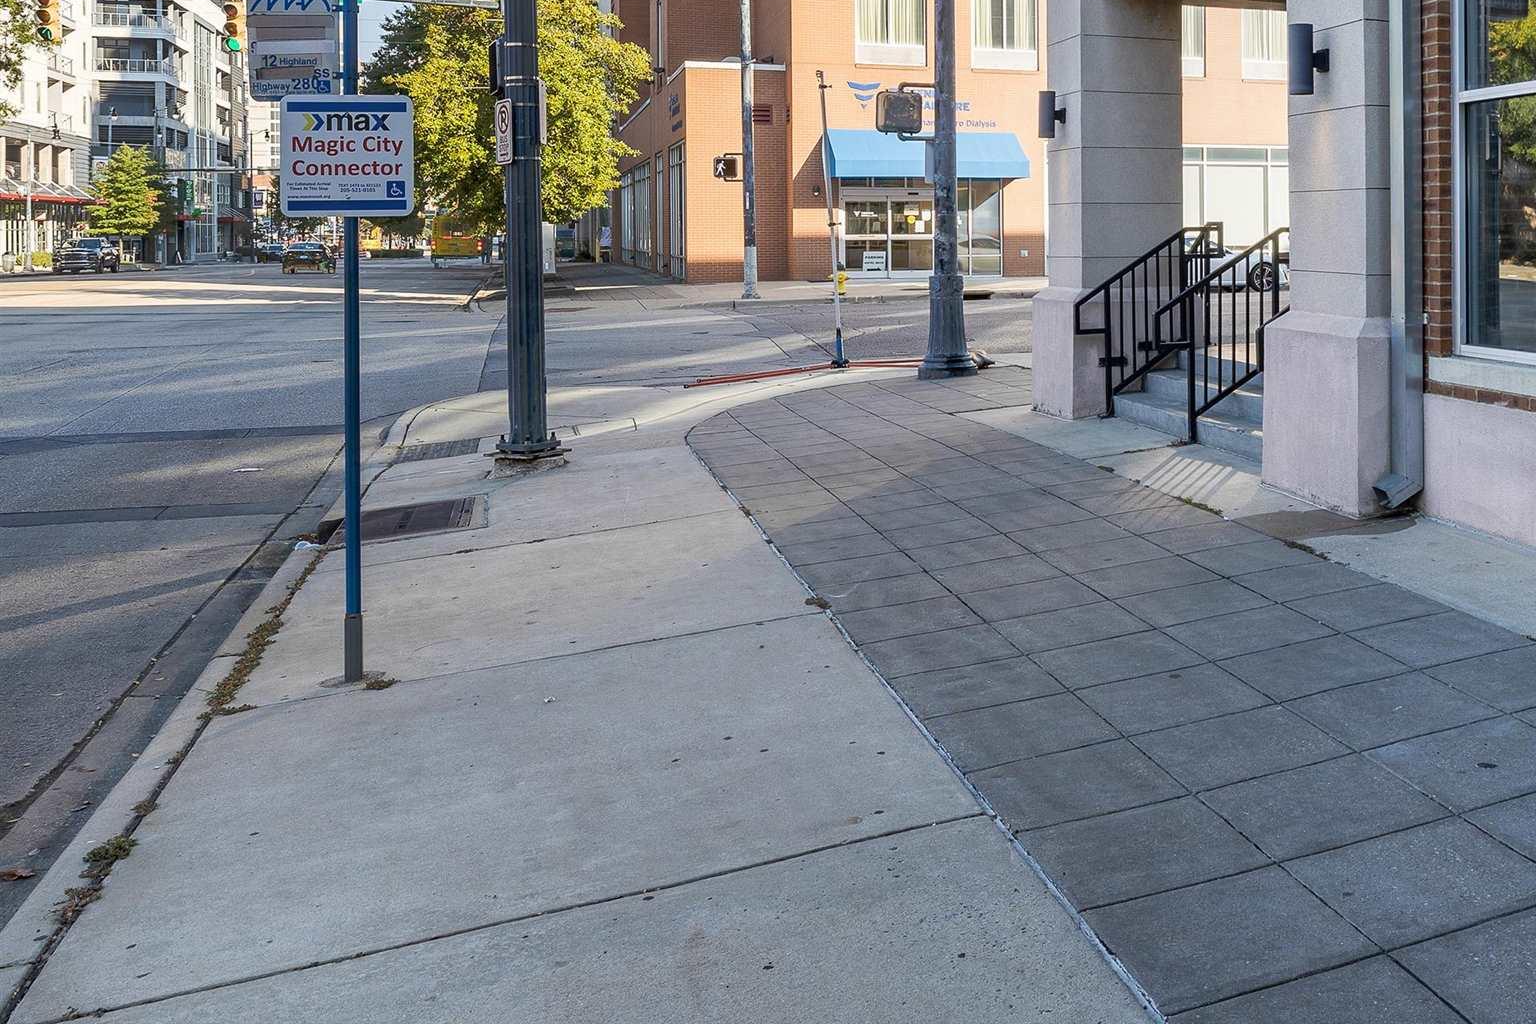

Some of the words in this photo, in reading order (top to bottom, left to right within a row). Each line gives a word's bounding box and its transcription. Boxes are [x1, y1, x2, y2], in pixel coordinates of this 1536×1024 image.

[262, 55, 277, 67] 12
[279, 57, 318, 68] Highland
[252, 82, 291, 93] Highway
[326, 112, 390, 131] max
[966, 120, 997, 129] Dialysis
[291, 136, 356, 156] Magic
[362, 136, 403, 156] City
[292, 160, 403, 176] Connector
